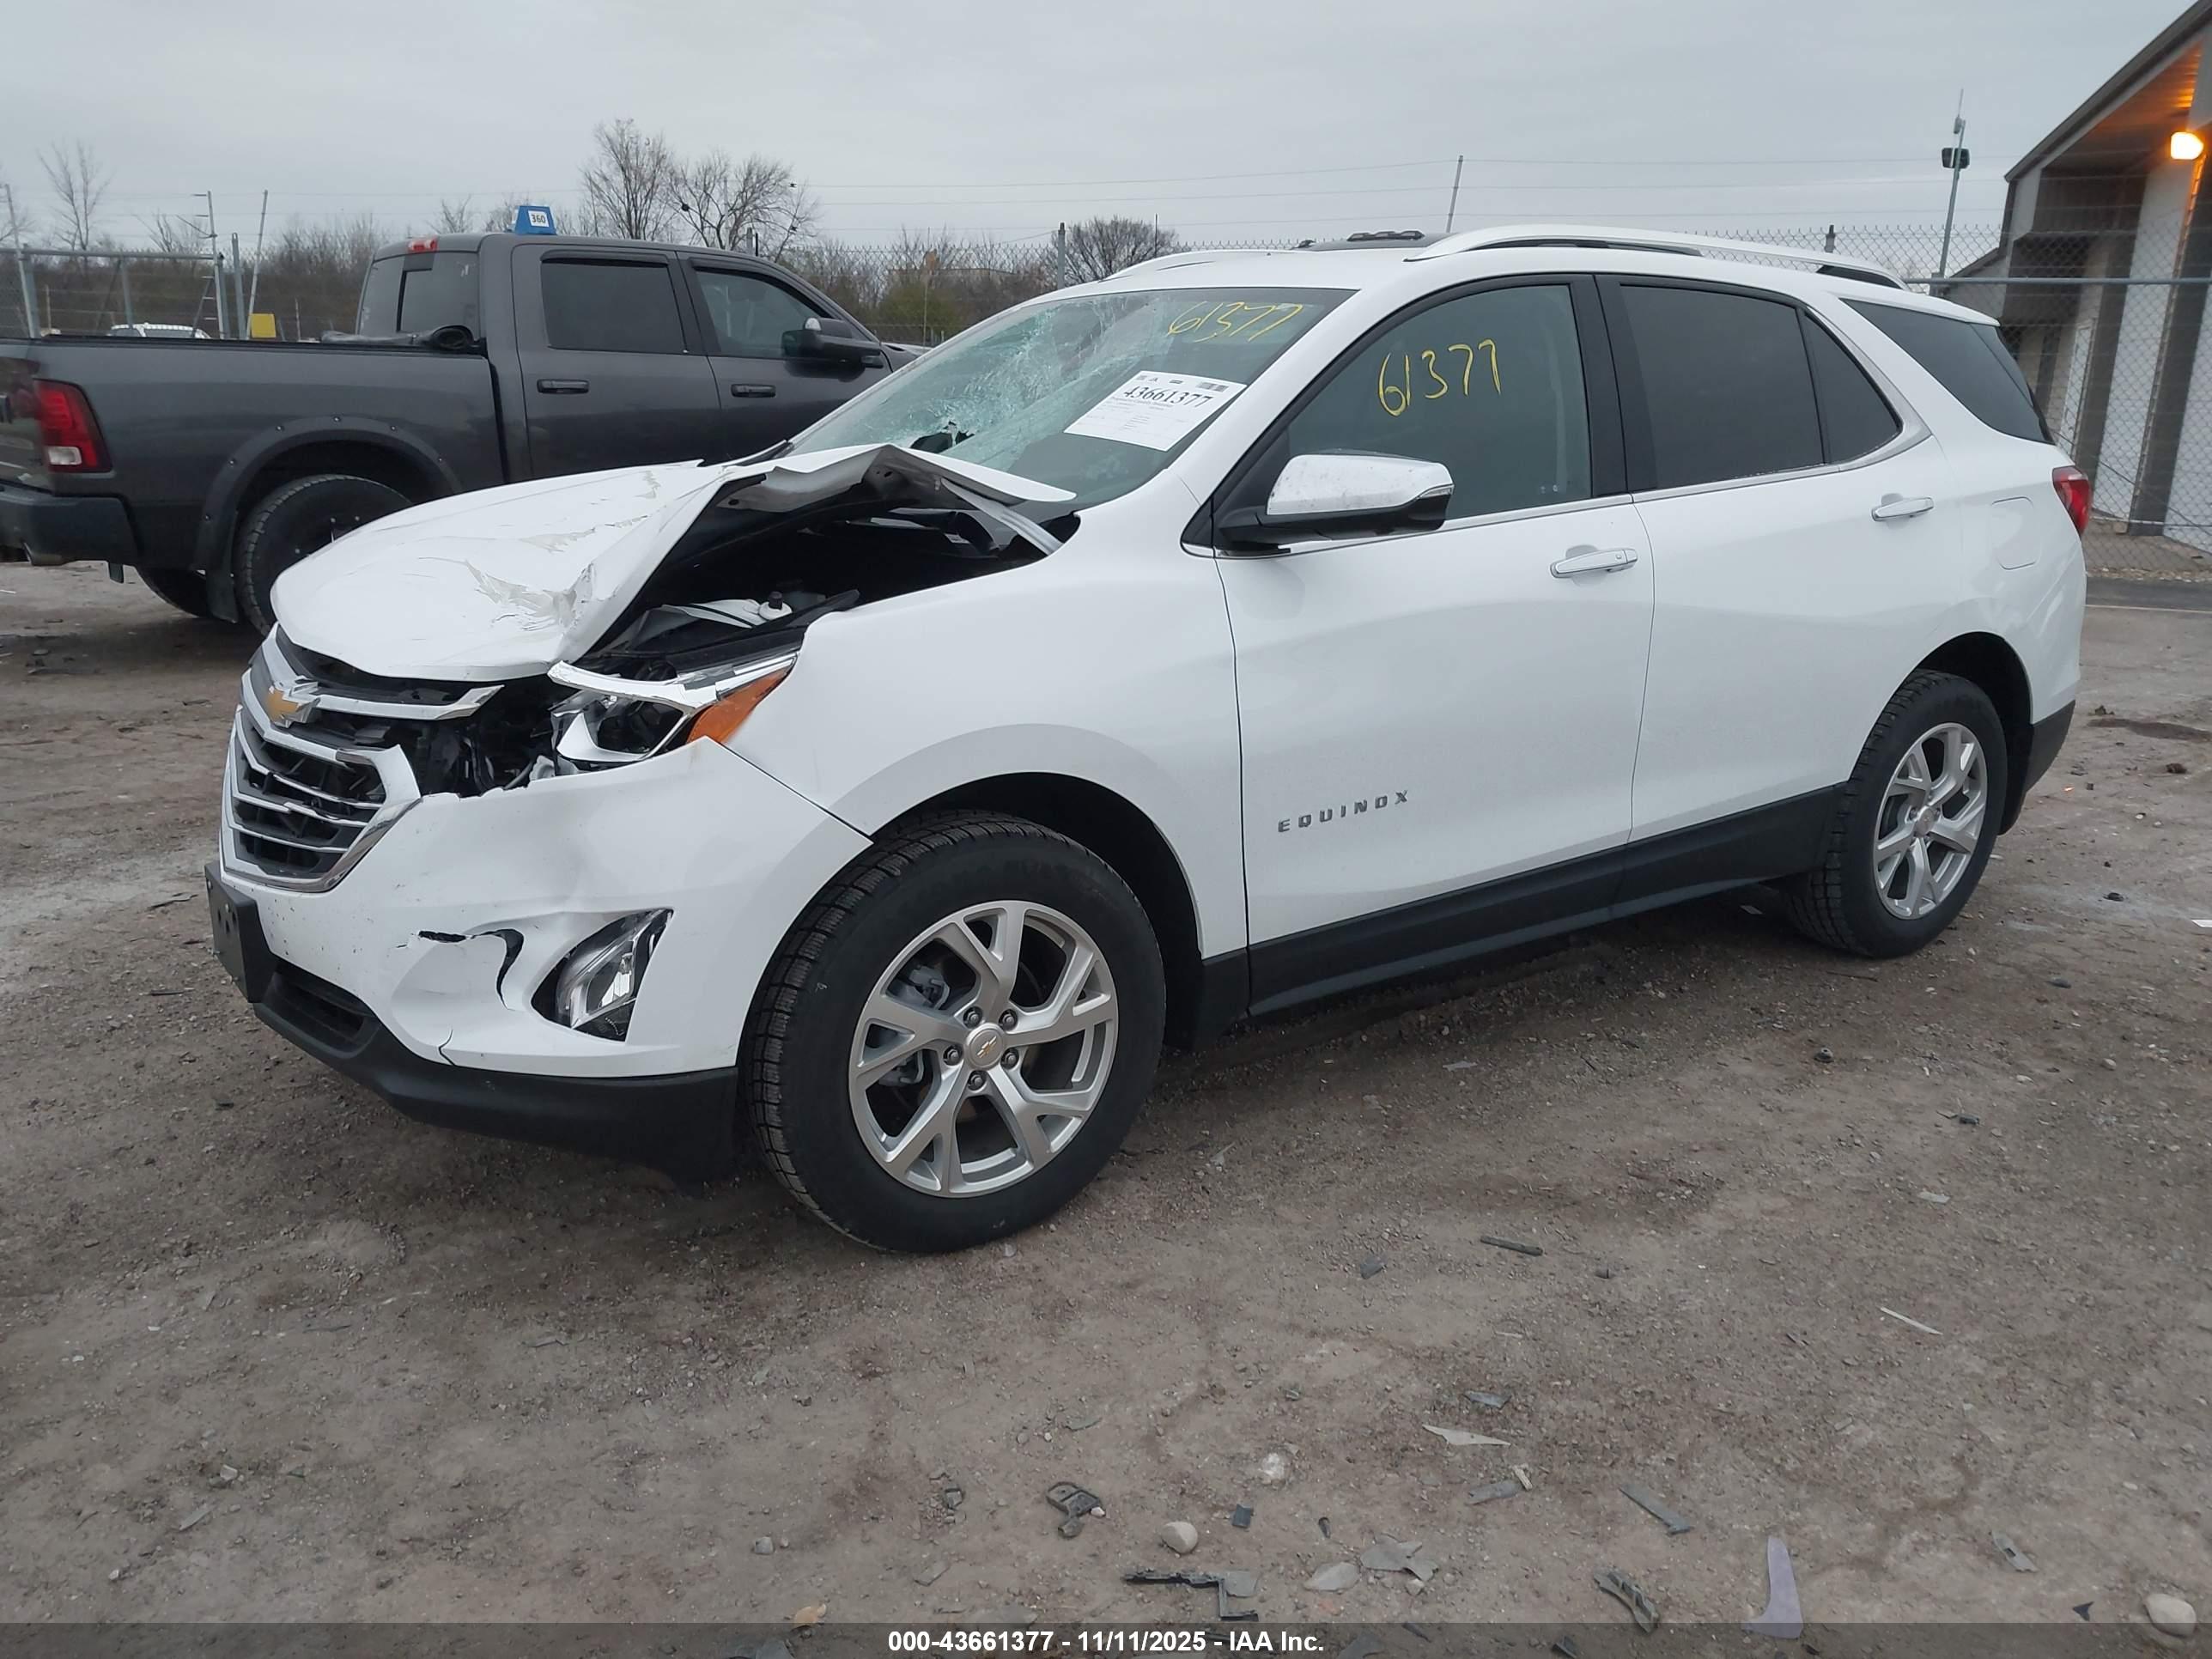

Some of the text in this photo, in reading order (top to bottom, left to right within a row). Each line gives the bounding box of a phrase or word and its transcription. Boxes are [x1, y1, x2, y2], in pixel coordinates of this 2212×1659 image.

[531, 214, 547, 224] 360
[1169, 301, 1303, 343] 61377
[1124, 385, 1213, 408] 43661377
[1378, 338, 1501, 416] 61377
[1278, 790, 1408, 833] EQUINOX
